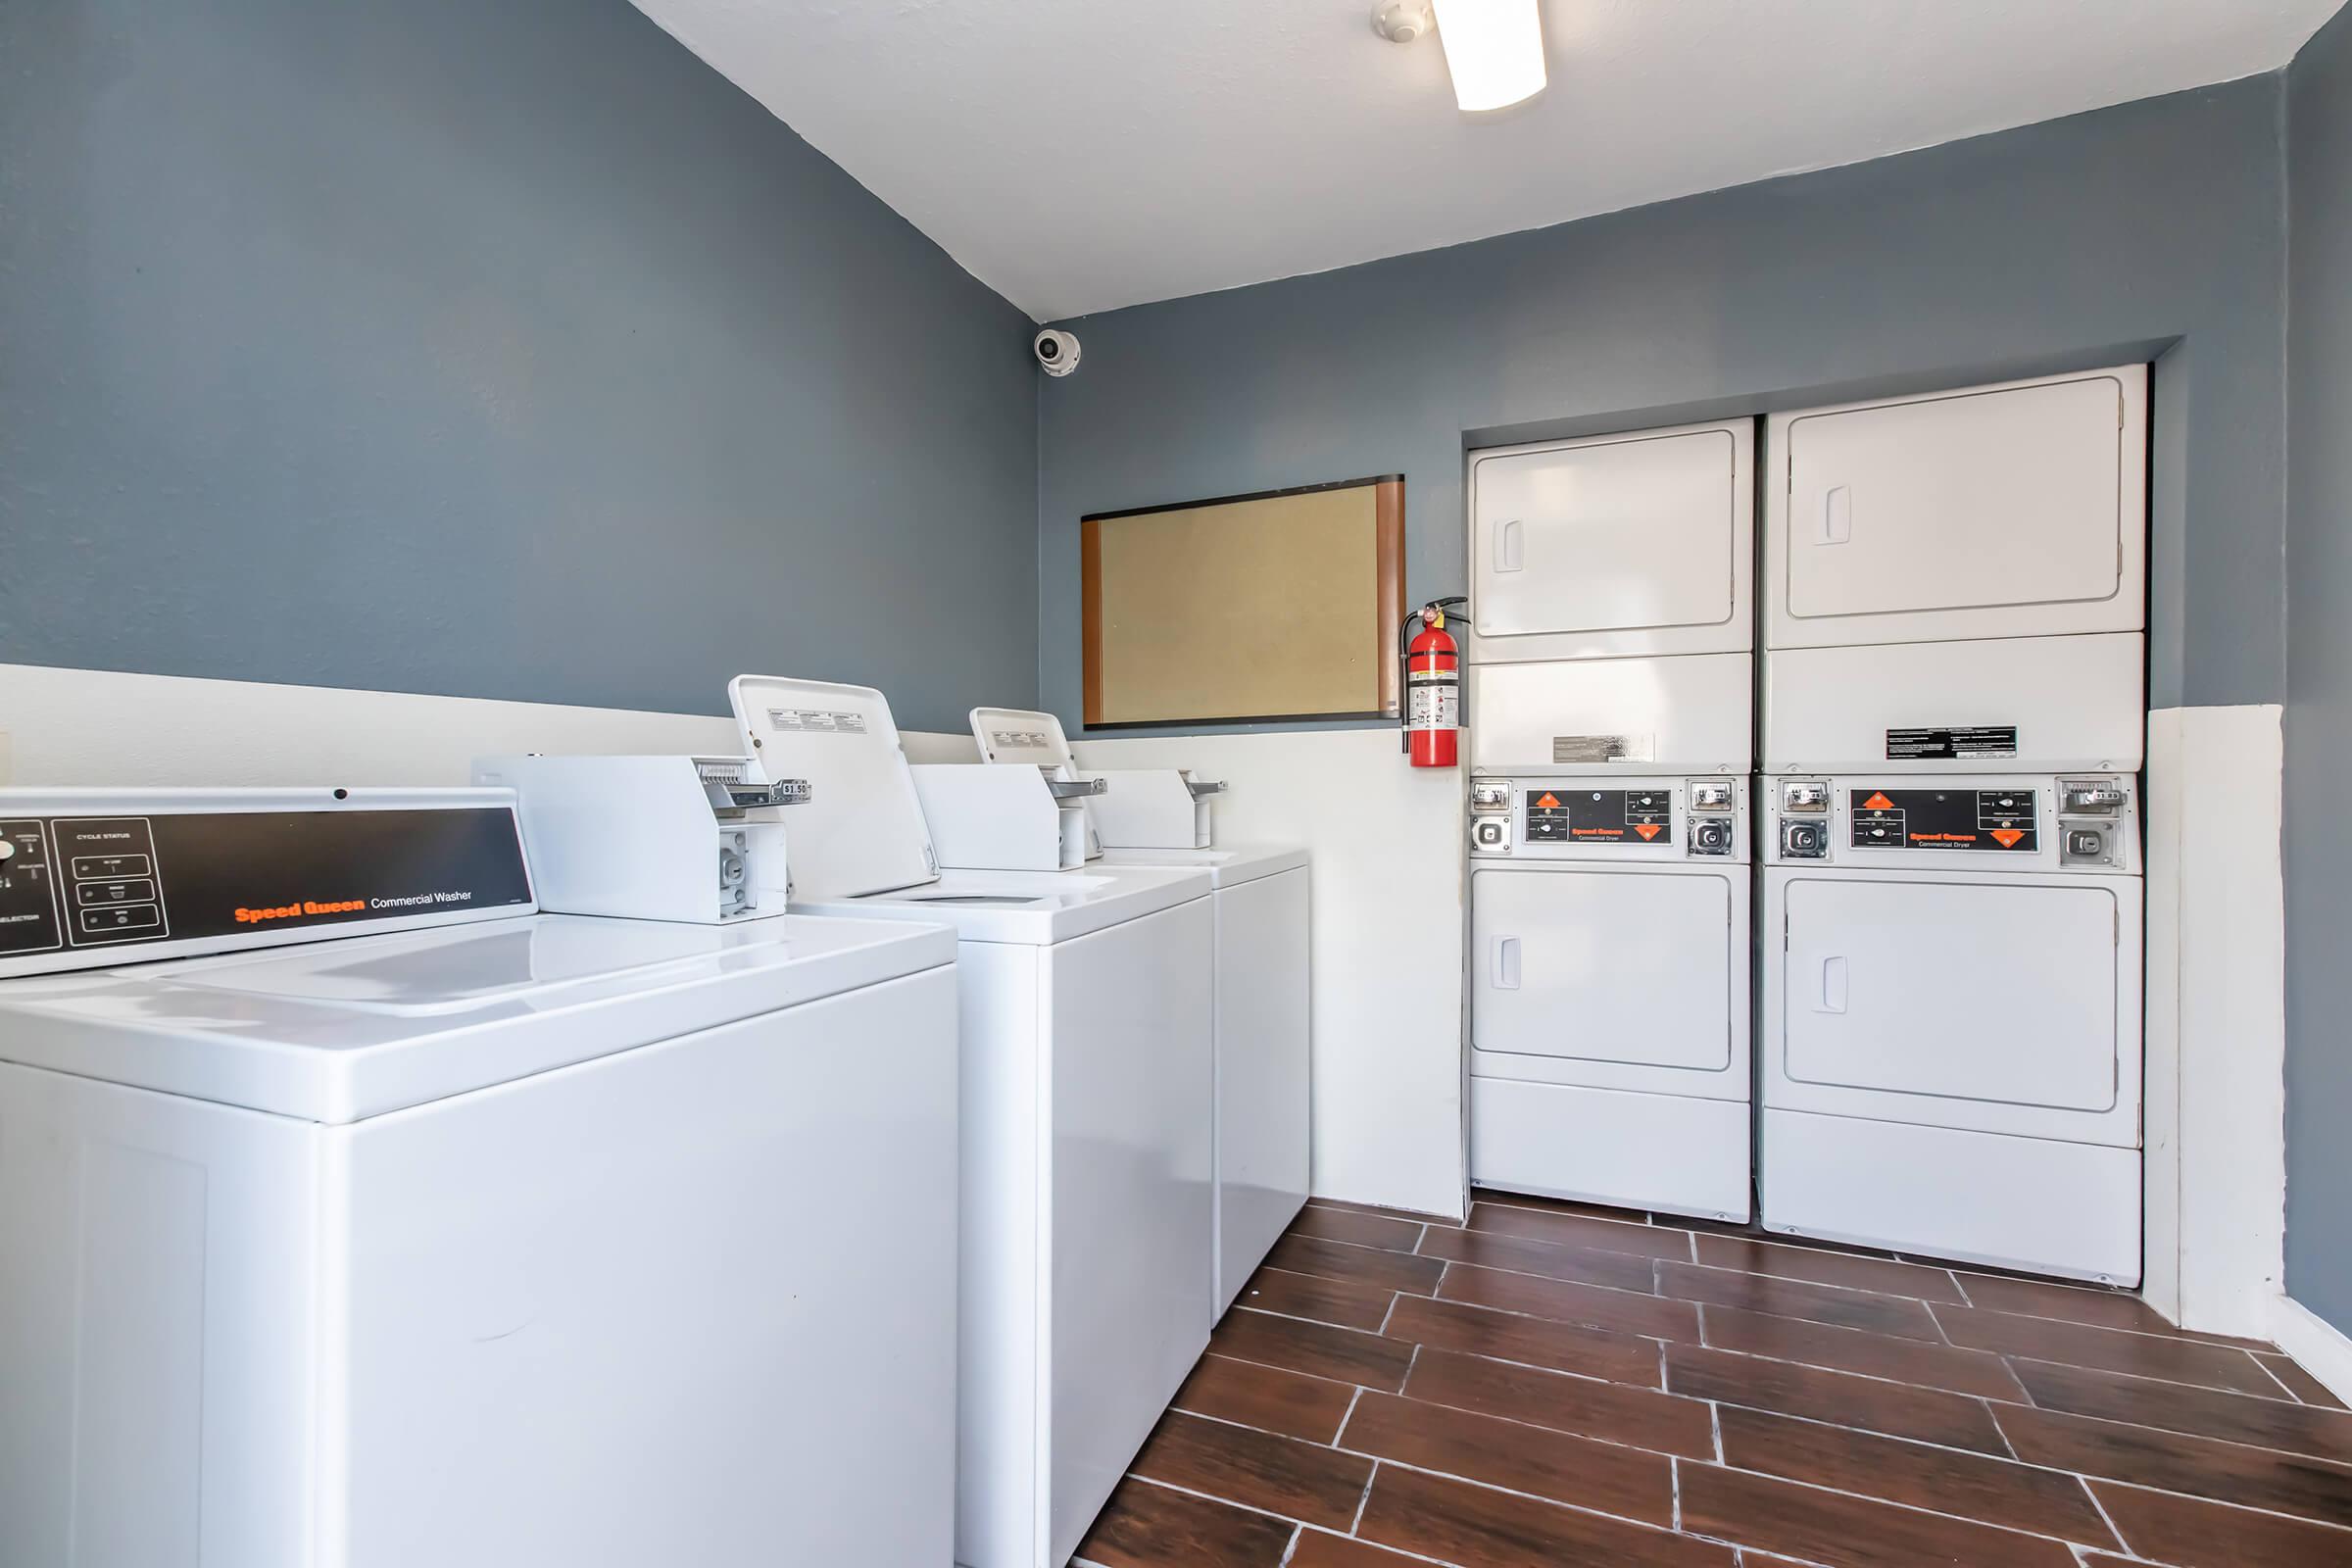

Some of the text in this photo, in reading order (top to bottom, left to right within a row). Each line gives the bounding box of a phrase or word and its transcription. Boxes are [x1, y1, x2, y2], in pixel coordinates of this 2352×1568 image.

[785, 785, 807, 794] $1.50
[370, 891, 471, 909] Commercial Washer
[235, 900, 366, 923] Speed Queen
